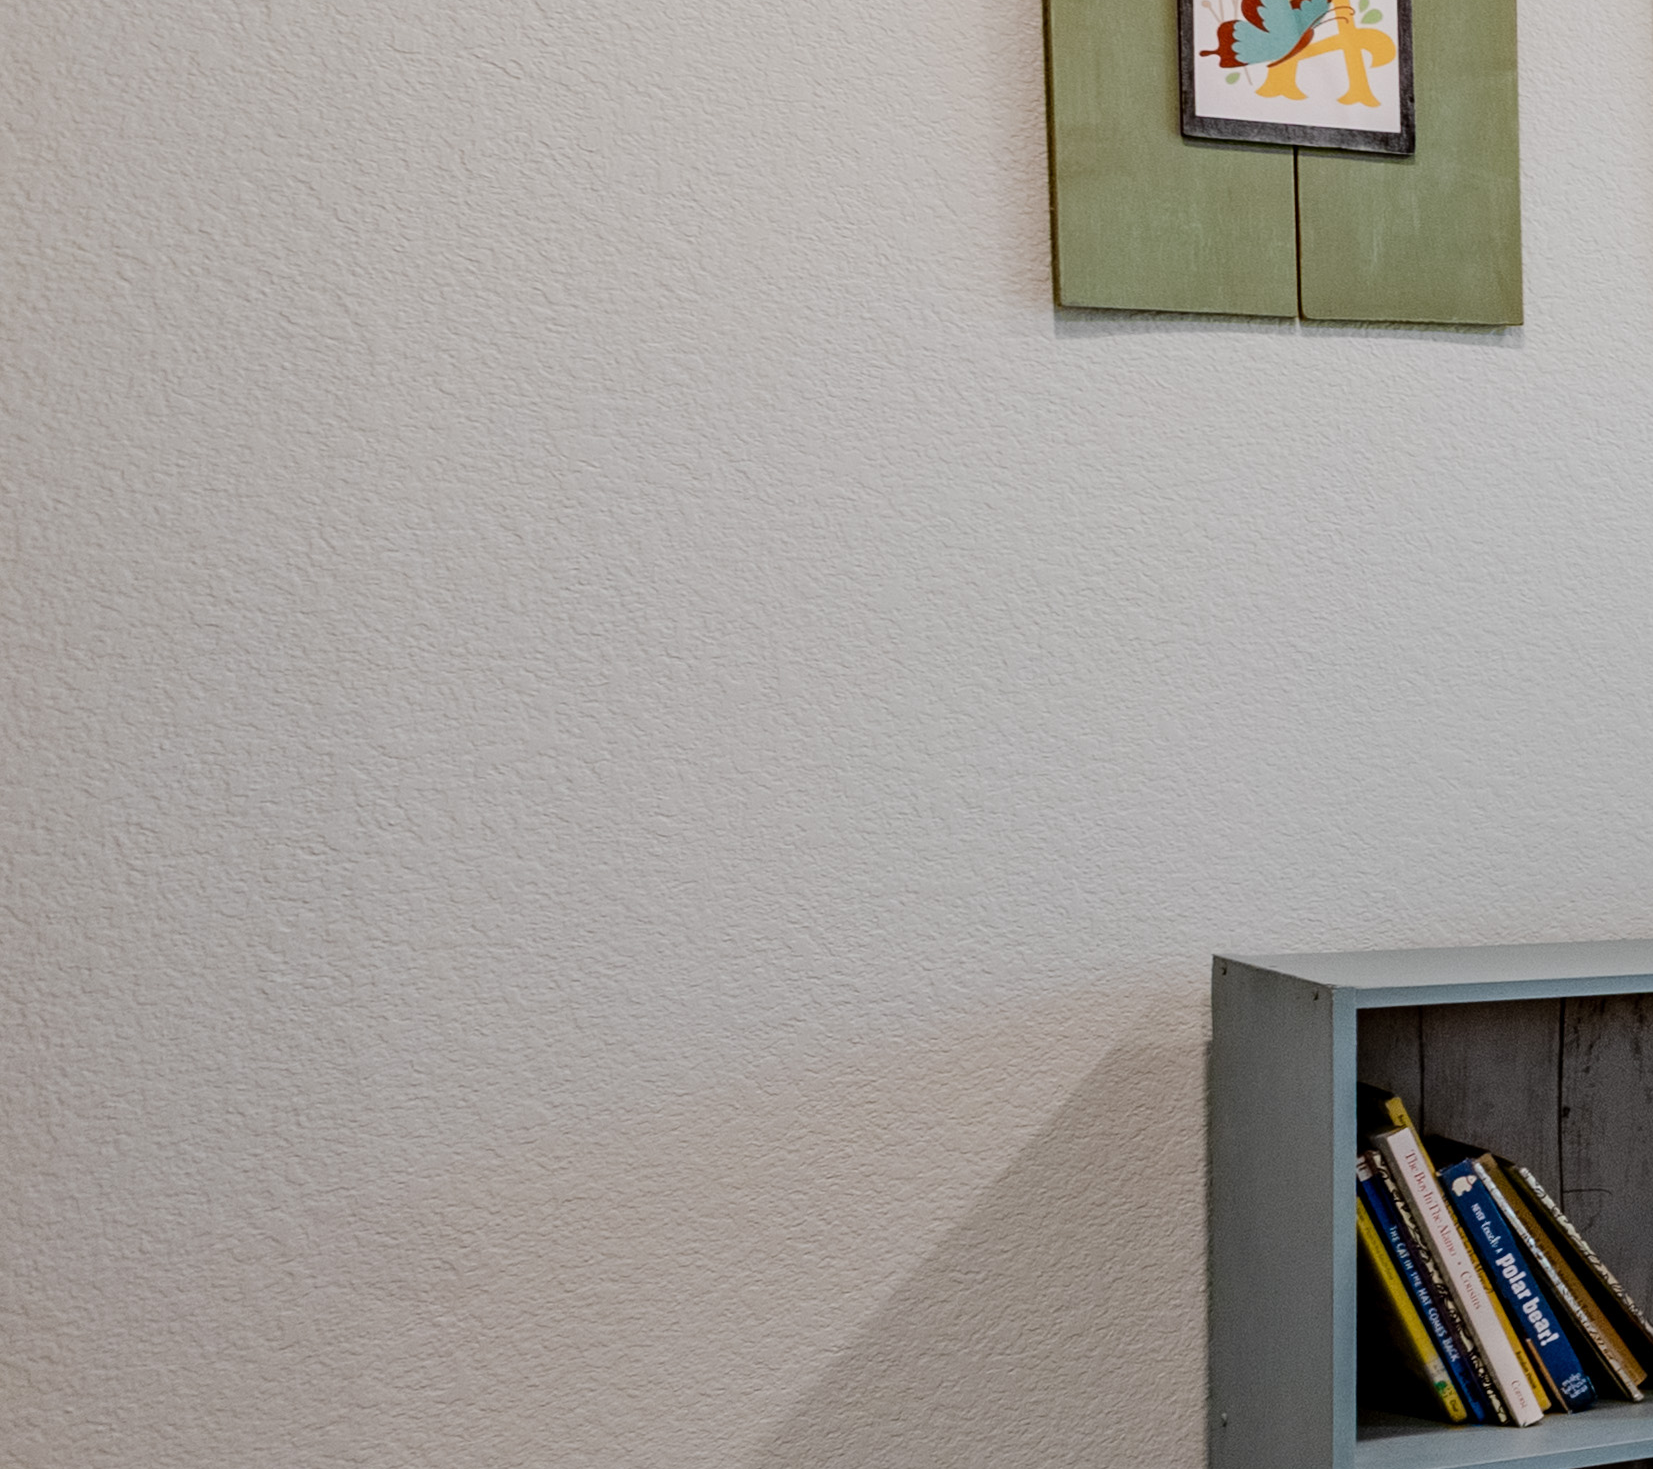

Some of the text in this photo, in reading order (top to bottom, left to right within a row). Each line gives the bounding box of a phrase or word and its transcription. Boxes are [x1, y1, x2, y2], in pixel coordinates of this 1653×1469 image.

[1405, 1148, 1420, 1173] The
[1414, 1171, 1428, 1193] Boy
[1423, 1190, 1434, 1206] In
[1428, 1202, 1444, 1225] The
[1437, 1224, 1459, 1258] Alamo
[1389, 1225, 1461, 1364] THE CAT IN THE HAT COMES BACK
[1459, 1269, 1482, 1310] Cousins
[1480, 1220, 1502, 1249] touch
[1521, 1296, 1560, 1347] bear!
